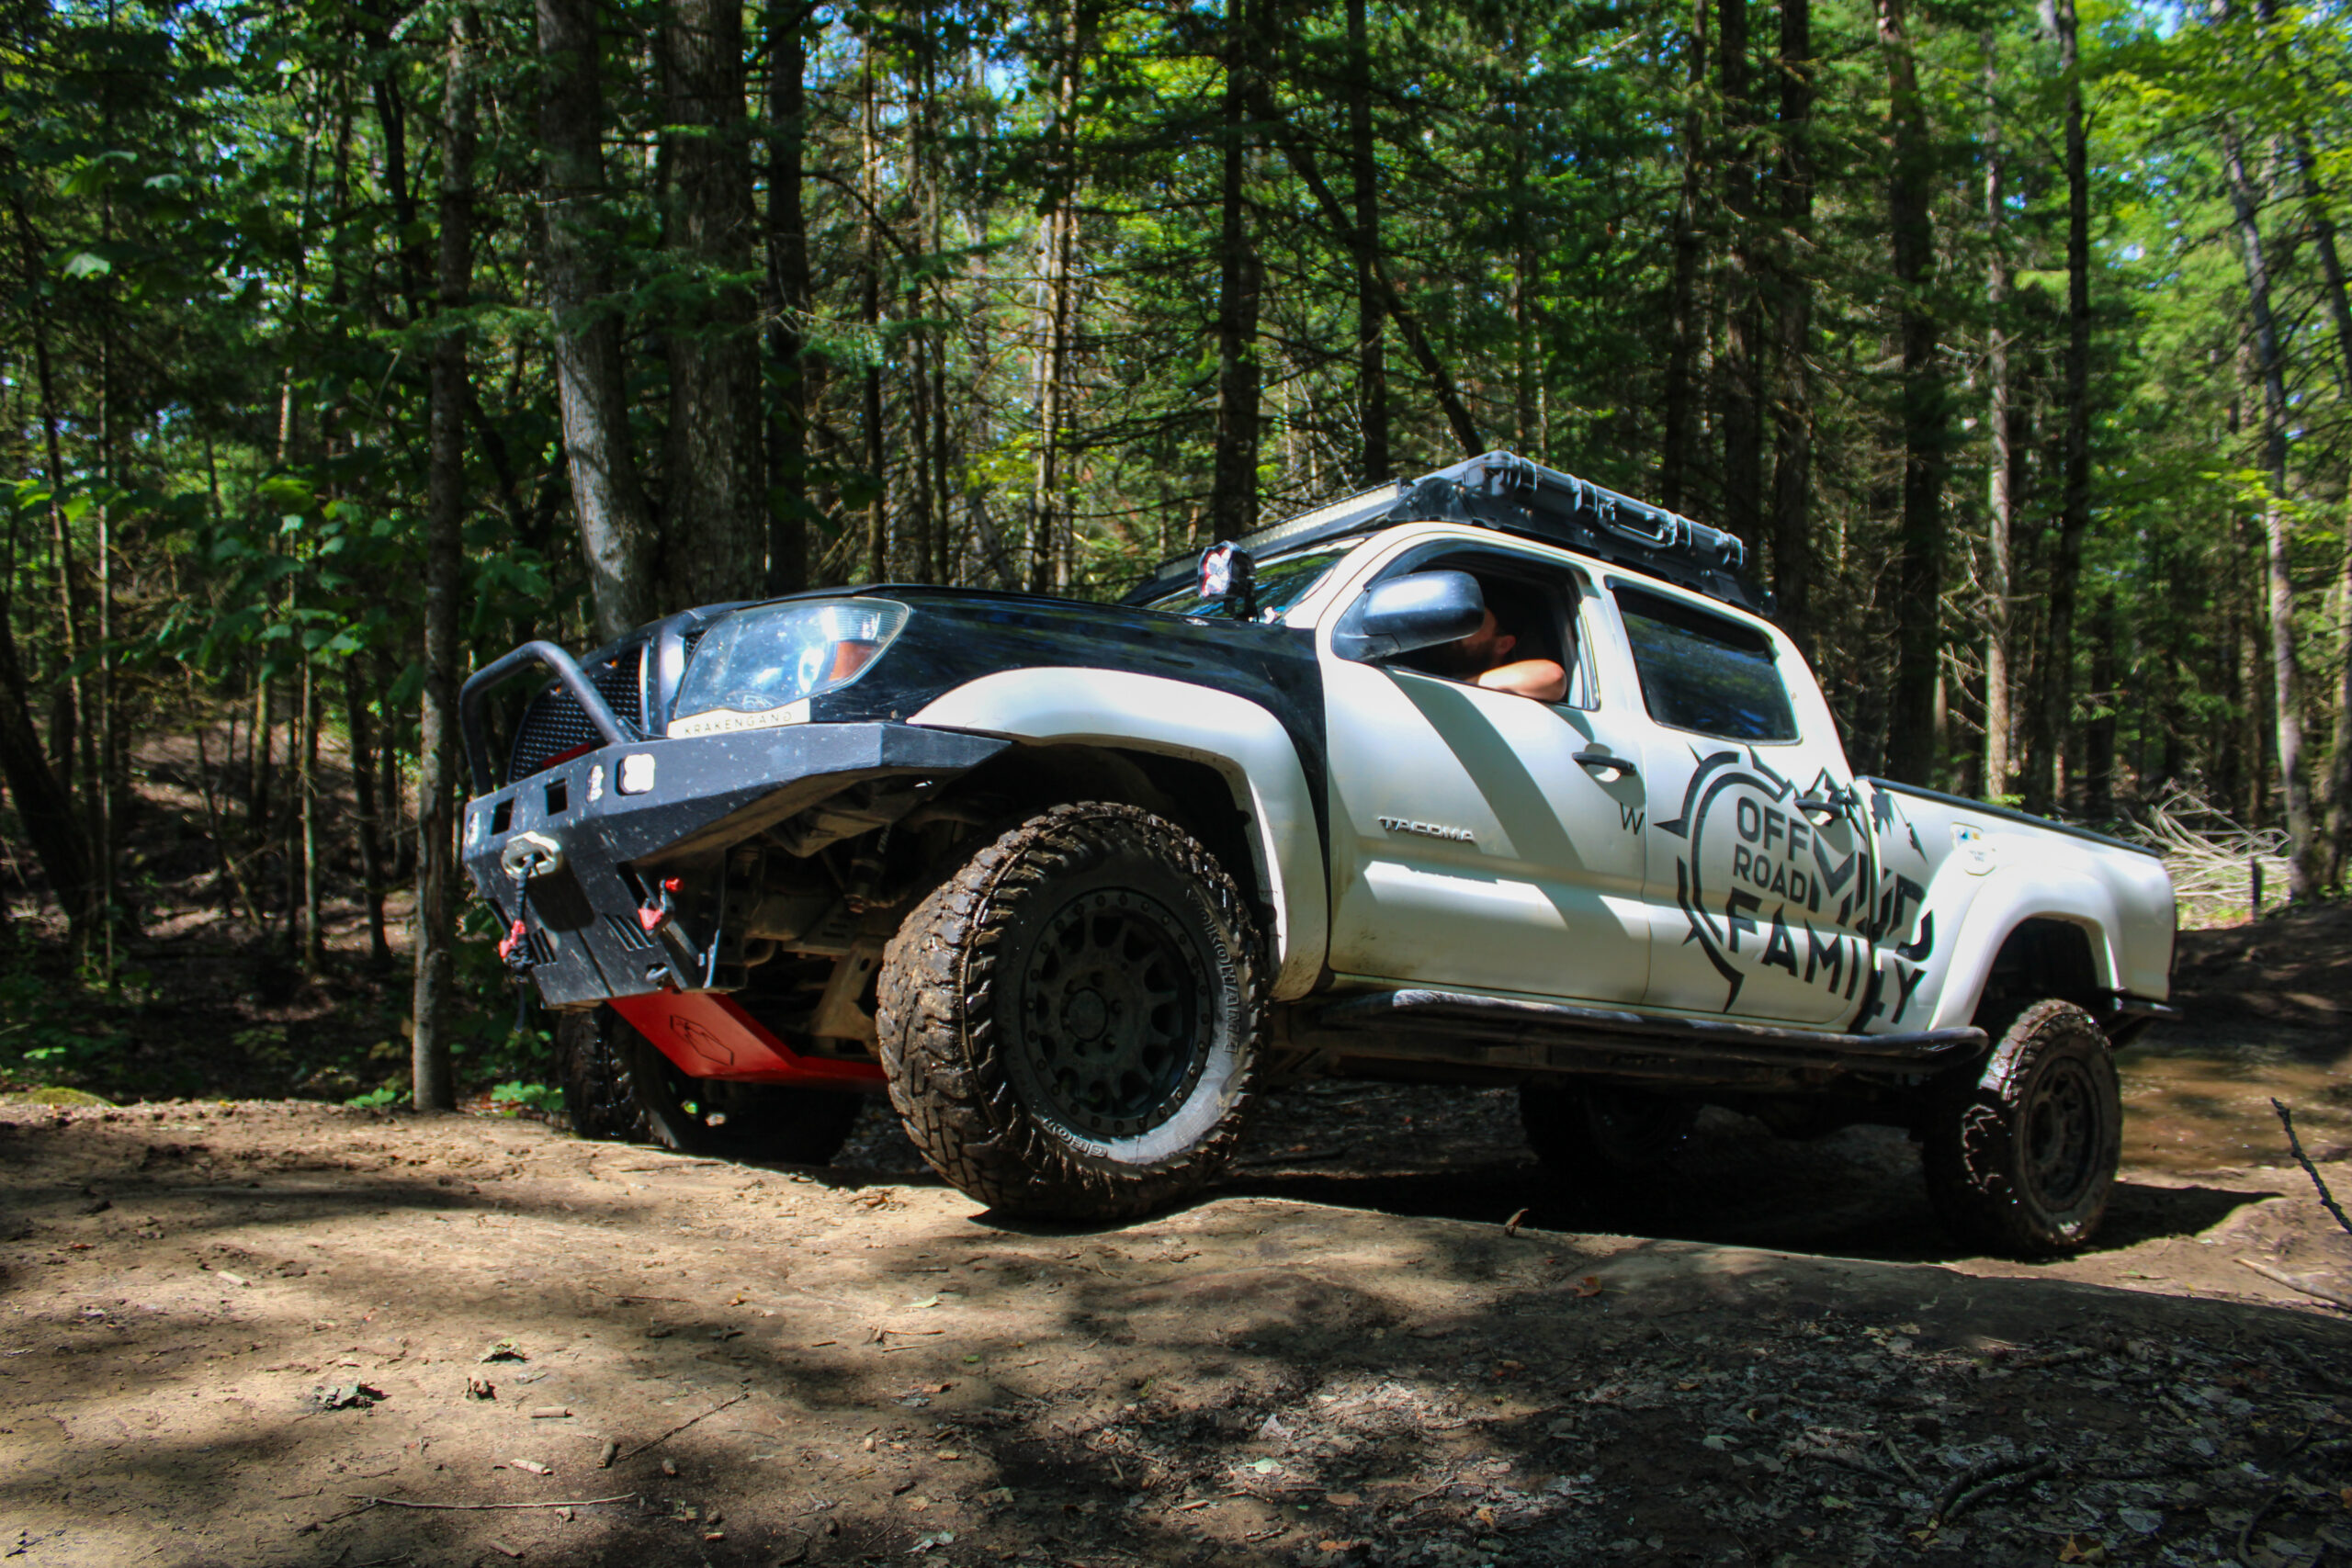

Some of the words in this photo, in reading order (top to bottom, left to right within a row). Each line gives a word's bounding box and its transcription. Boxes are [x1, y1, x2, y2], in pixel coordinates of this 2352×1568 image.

[1377, 815, 1475, 842] TACOMA
[1620, 802, 1645, 836] W
[1736, 795, 1810, 862] OFF
[1733, 843, 1808, 905] ROAD
[1192, 895, 1242, 1055] OKOHAMA
[1725, 886, 1928, 1033] FAMILY
